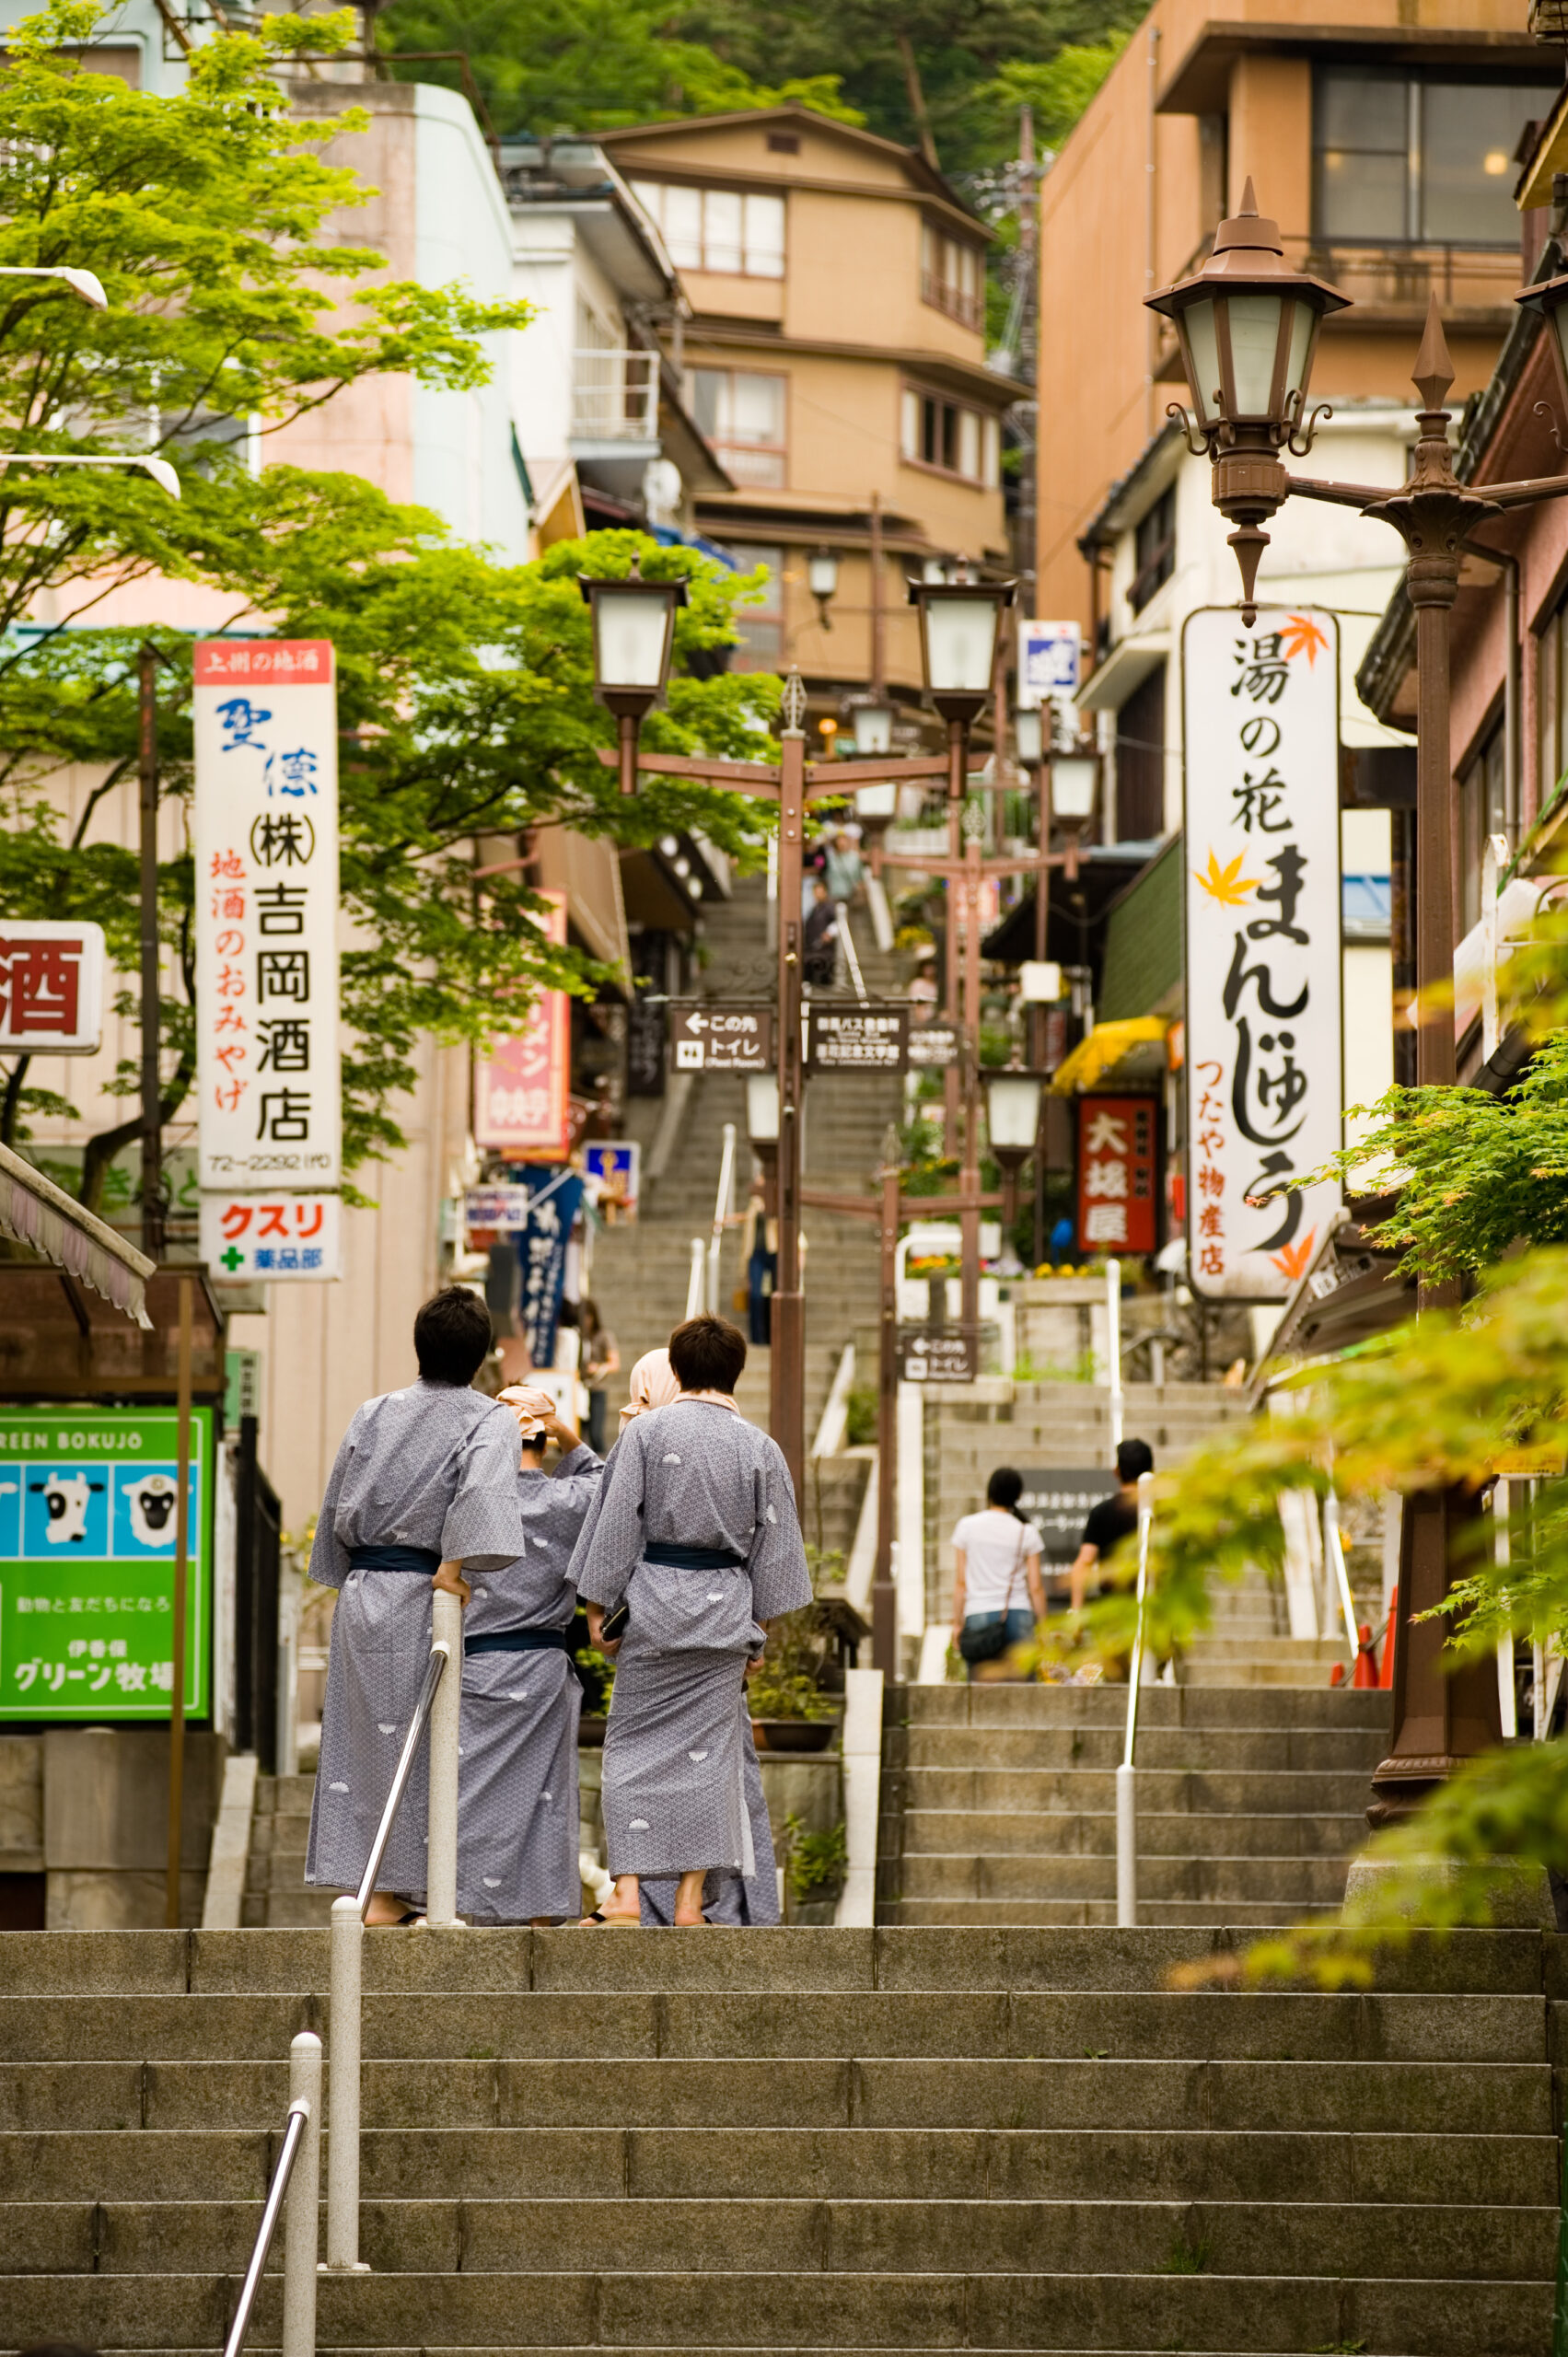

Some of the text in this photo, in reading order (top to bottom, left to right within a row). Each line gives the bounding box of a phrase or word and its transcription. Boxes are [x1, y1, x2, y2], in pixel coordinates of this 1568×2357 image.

[203, 649, 319, 673] 上州の地酒
[210, 848, 248, 1112] 地酒のおみやげ
[250, 813, 315, 1141] (株)吉岡酒店
[710, 1016, 759, 1033] この先
[711, 1038, 761, 1056] トイレ
[1196, 1061, 1227, 1277] つたや物産店
[221, 1203, 323, 1240] クスリ
[254, 1248, 322, 1270] 薬品部
[68, 1640, 128, 1657] 伊香保
[15, 1657, 175, 1691] グリーン牧場
